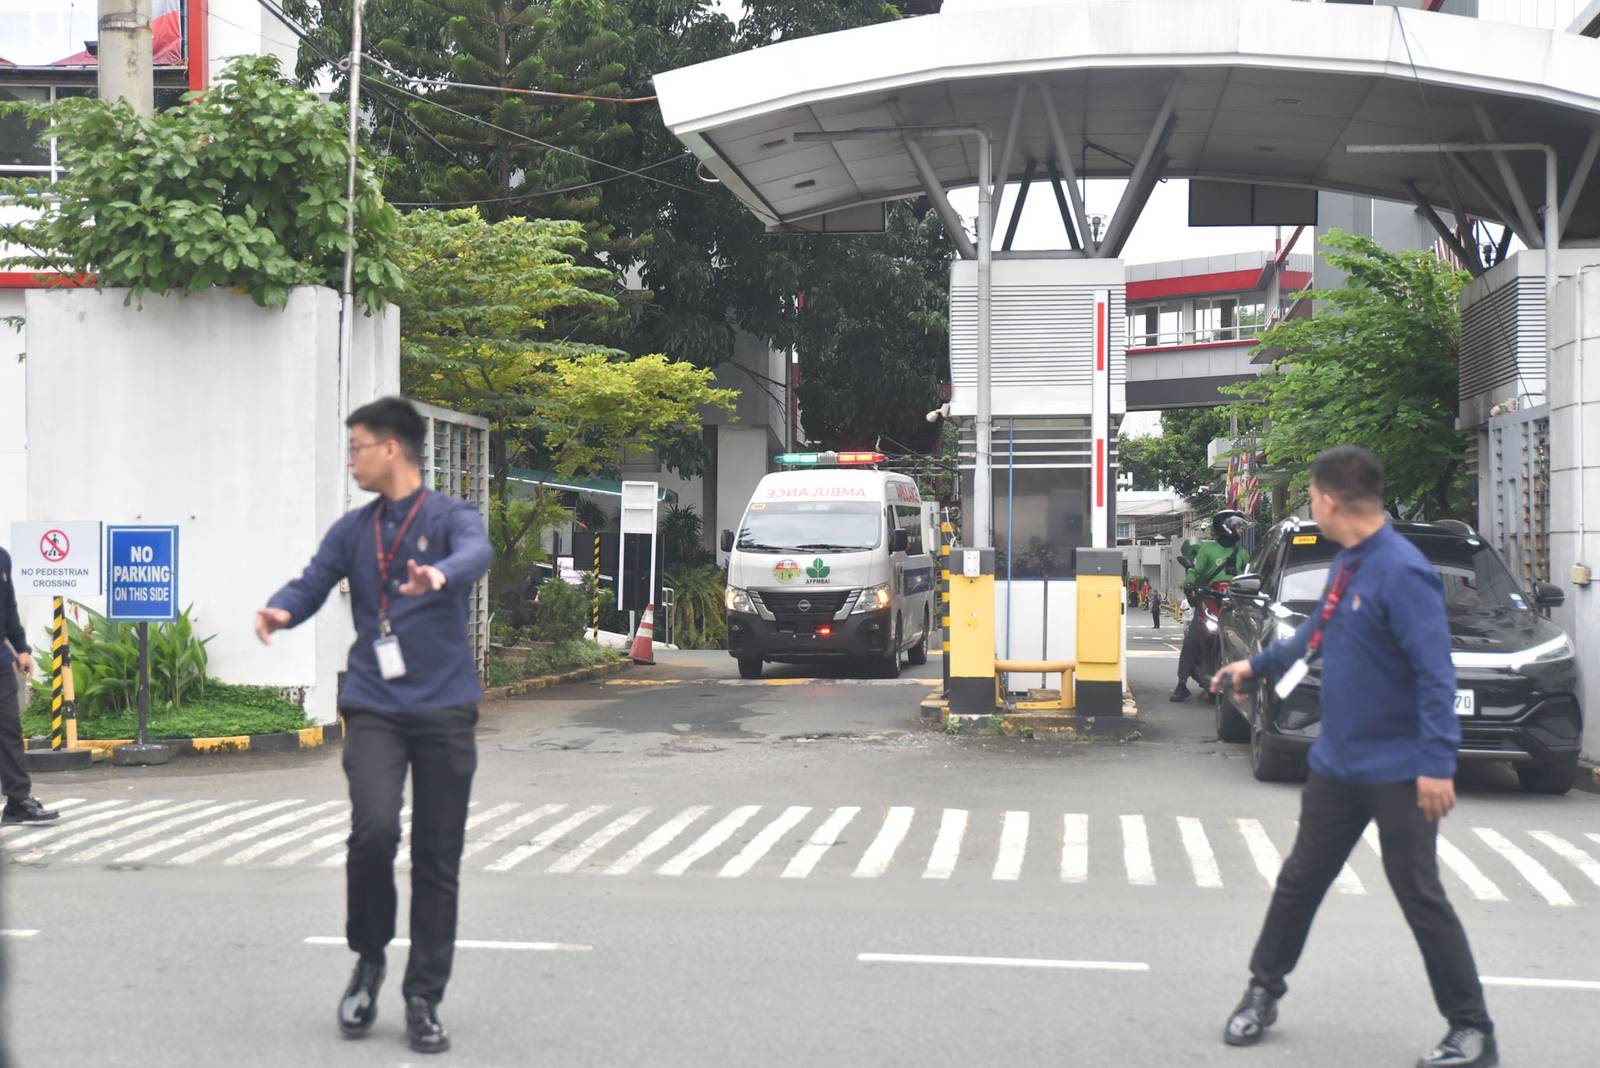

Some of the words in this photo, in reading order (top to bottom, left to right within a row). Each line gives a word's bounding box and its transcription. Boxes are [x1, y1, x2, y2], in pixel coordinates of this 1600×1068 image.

[131, 546, 153, 563] NO
[21, 568, 34, 576] NO
[35, 568, 89, 576] PEDESTRIAN
[114, 565, 170, 582] PARKING
[33, 579, 77, 587] CROSSING
[114, 587, 127, 601] ON
[129, 587, 148, 601] THIS
[150, 587, 169, 601] SIDE
